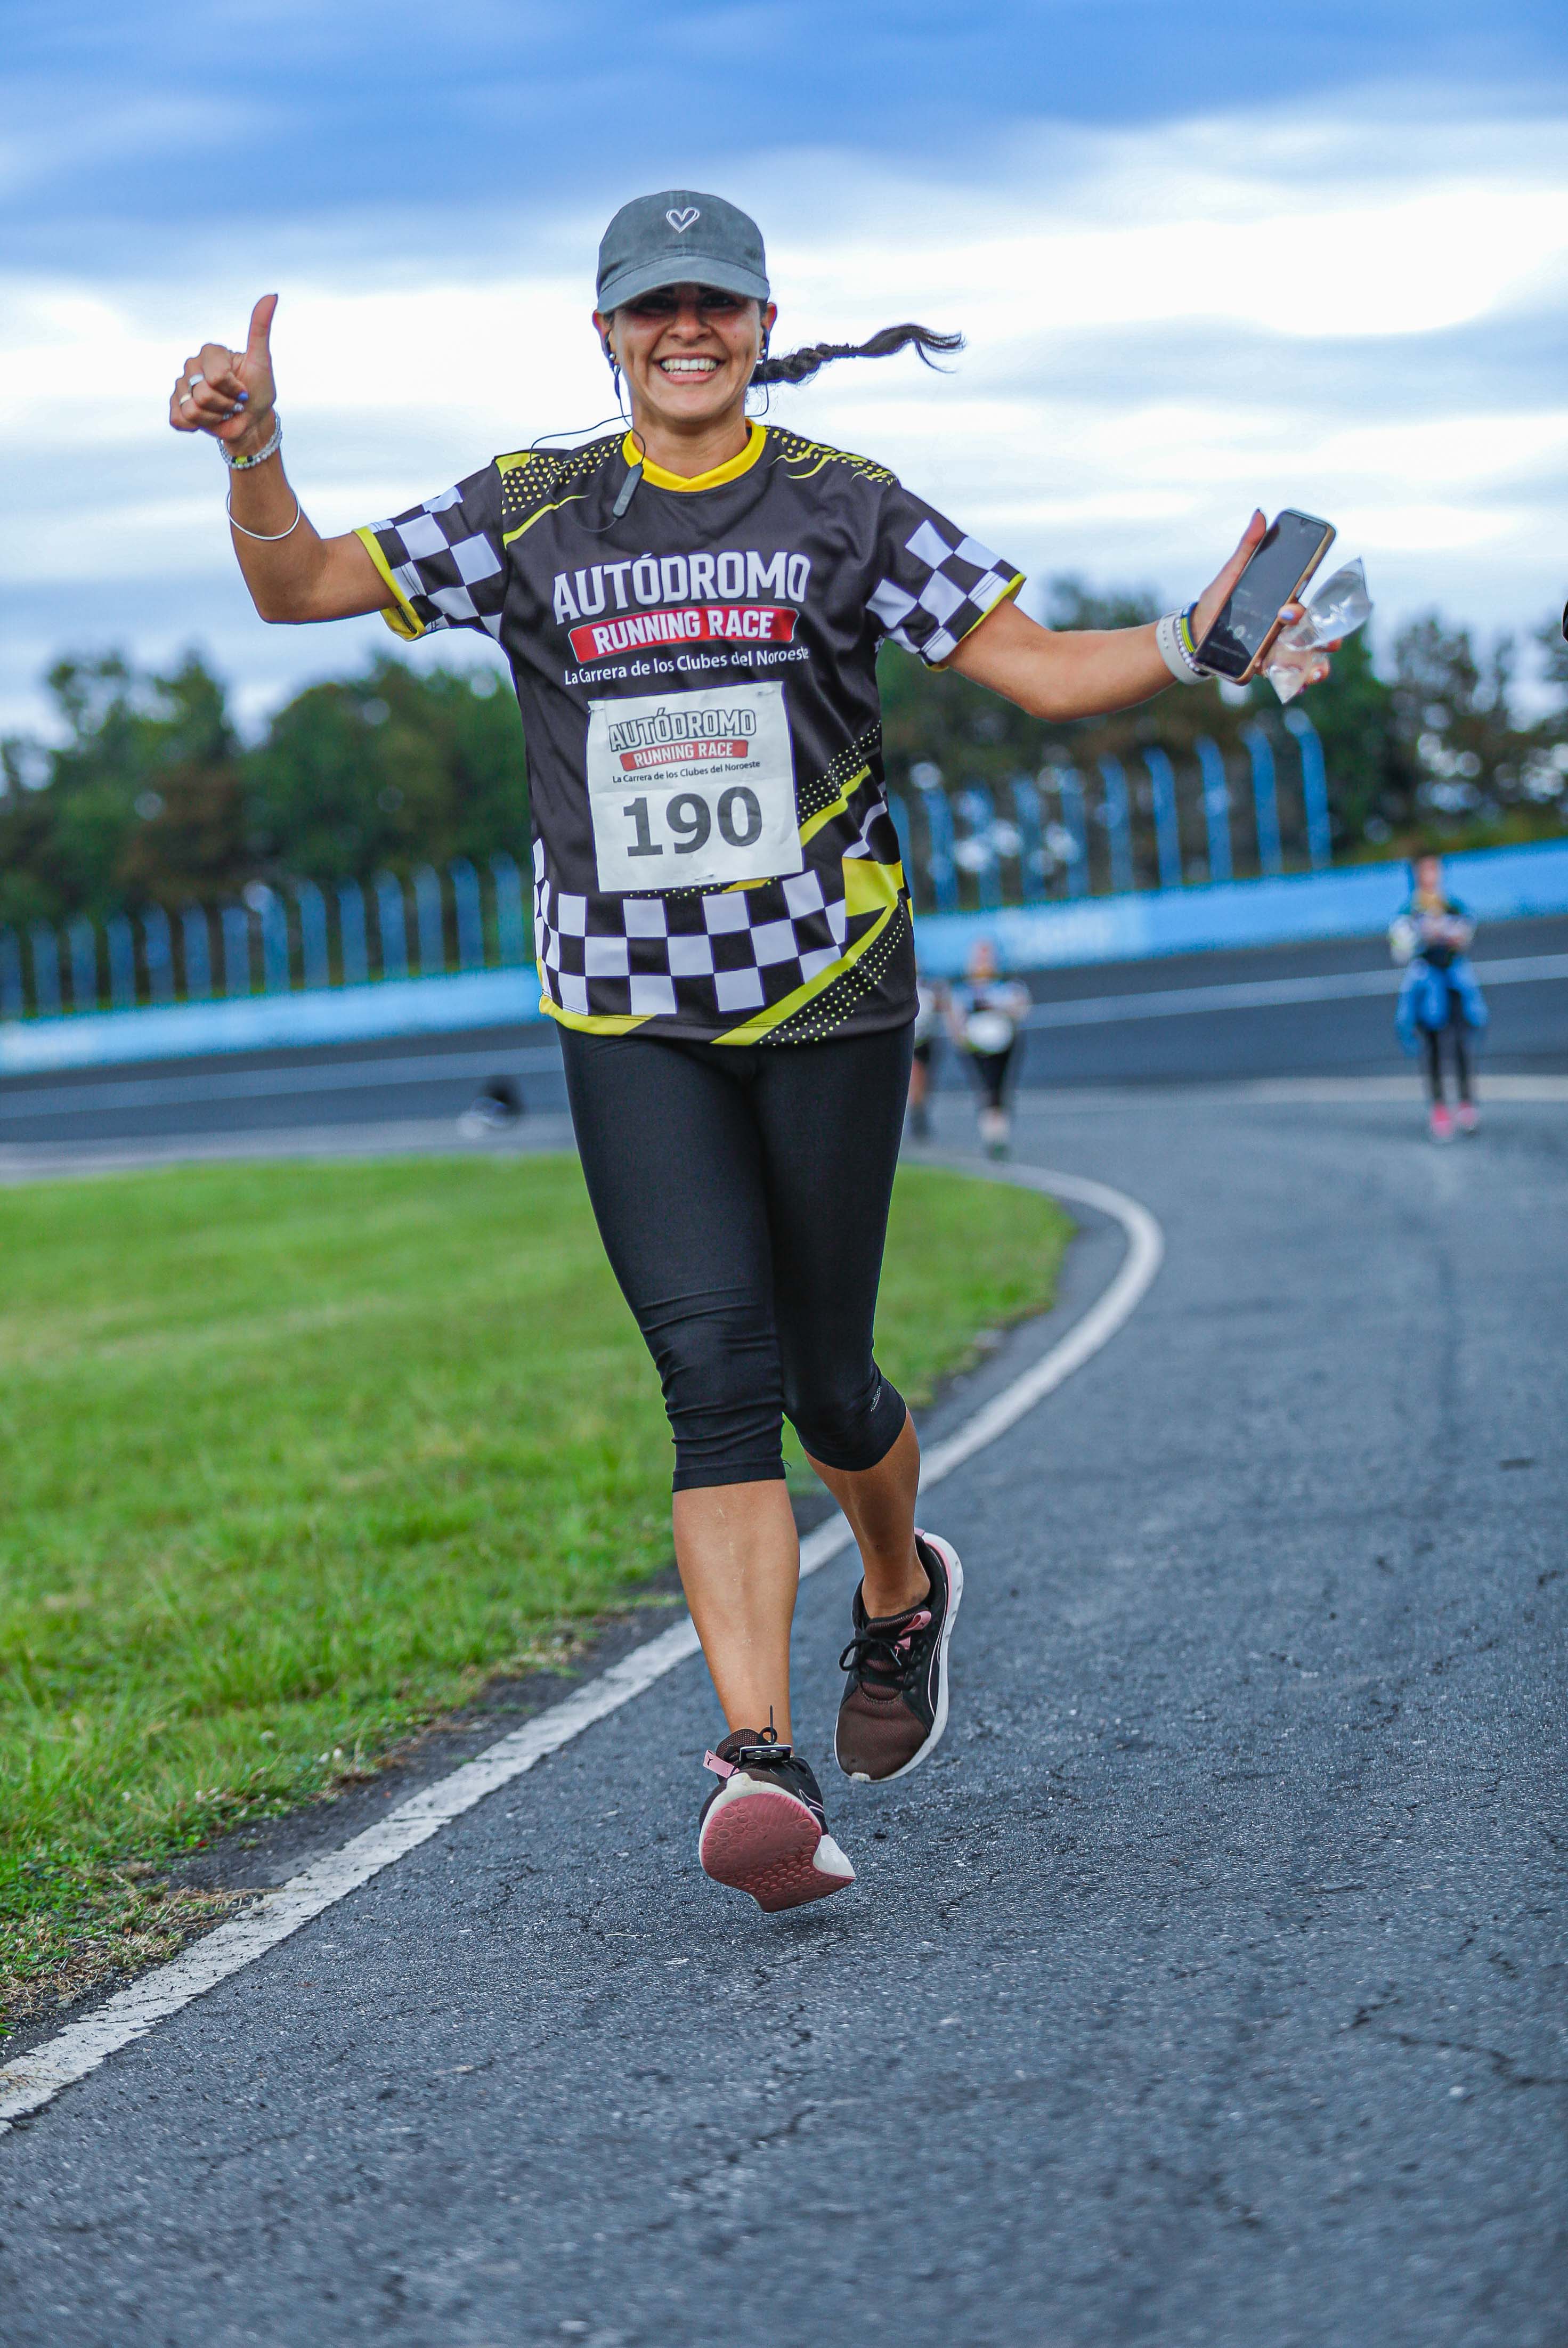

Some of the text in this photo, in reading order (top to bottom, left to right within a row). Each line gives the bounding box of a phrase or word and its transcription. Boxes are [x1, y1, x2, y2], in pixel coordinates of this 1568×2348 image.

[553, 551, 811, 625] AUTÓDROMO
[591, 610, 774, 655] RUNNING RACE
[565, 646, 809, 685] La Carrera de los Clubes del Noroeste
[608, 707, 757, 752] AUTÓDROMO
[623, 774, 652, 783] Carrera
[654, 771, 664, 780] de
[680, 767, 709, 777] Clubes
[710, 765, 723, 774] del
[725, 761, 760, 772] Noroeste
[633, 742, 734, 768] RUNNING RACE
[622, 786, 762, 857] 190
